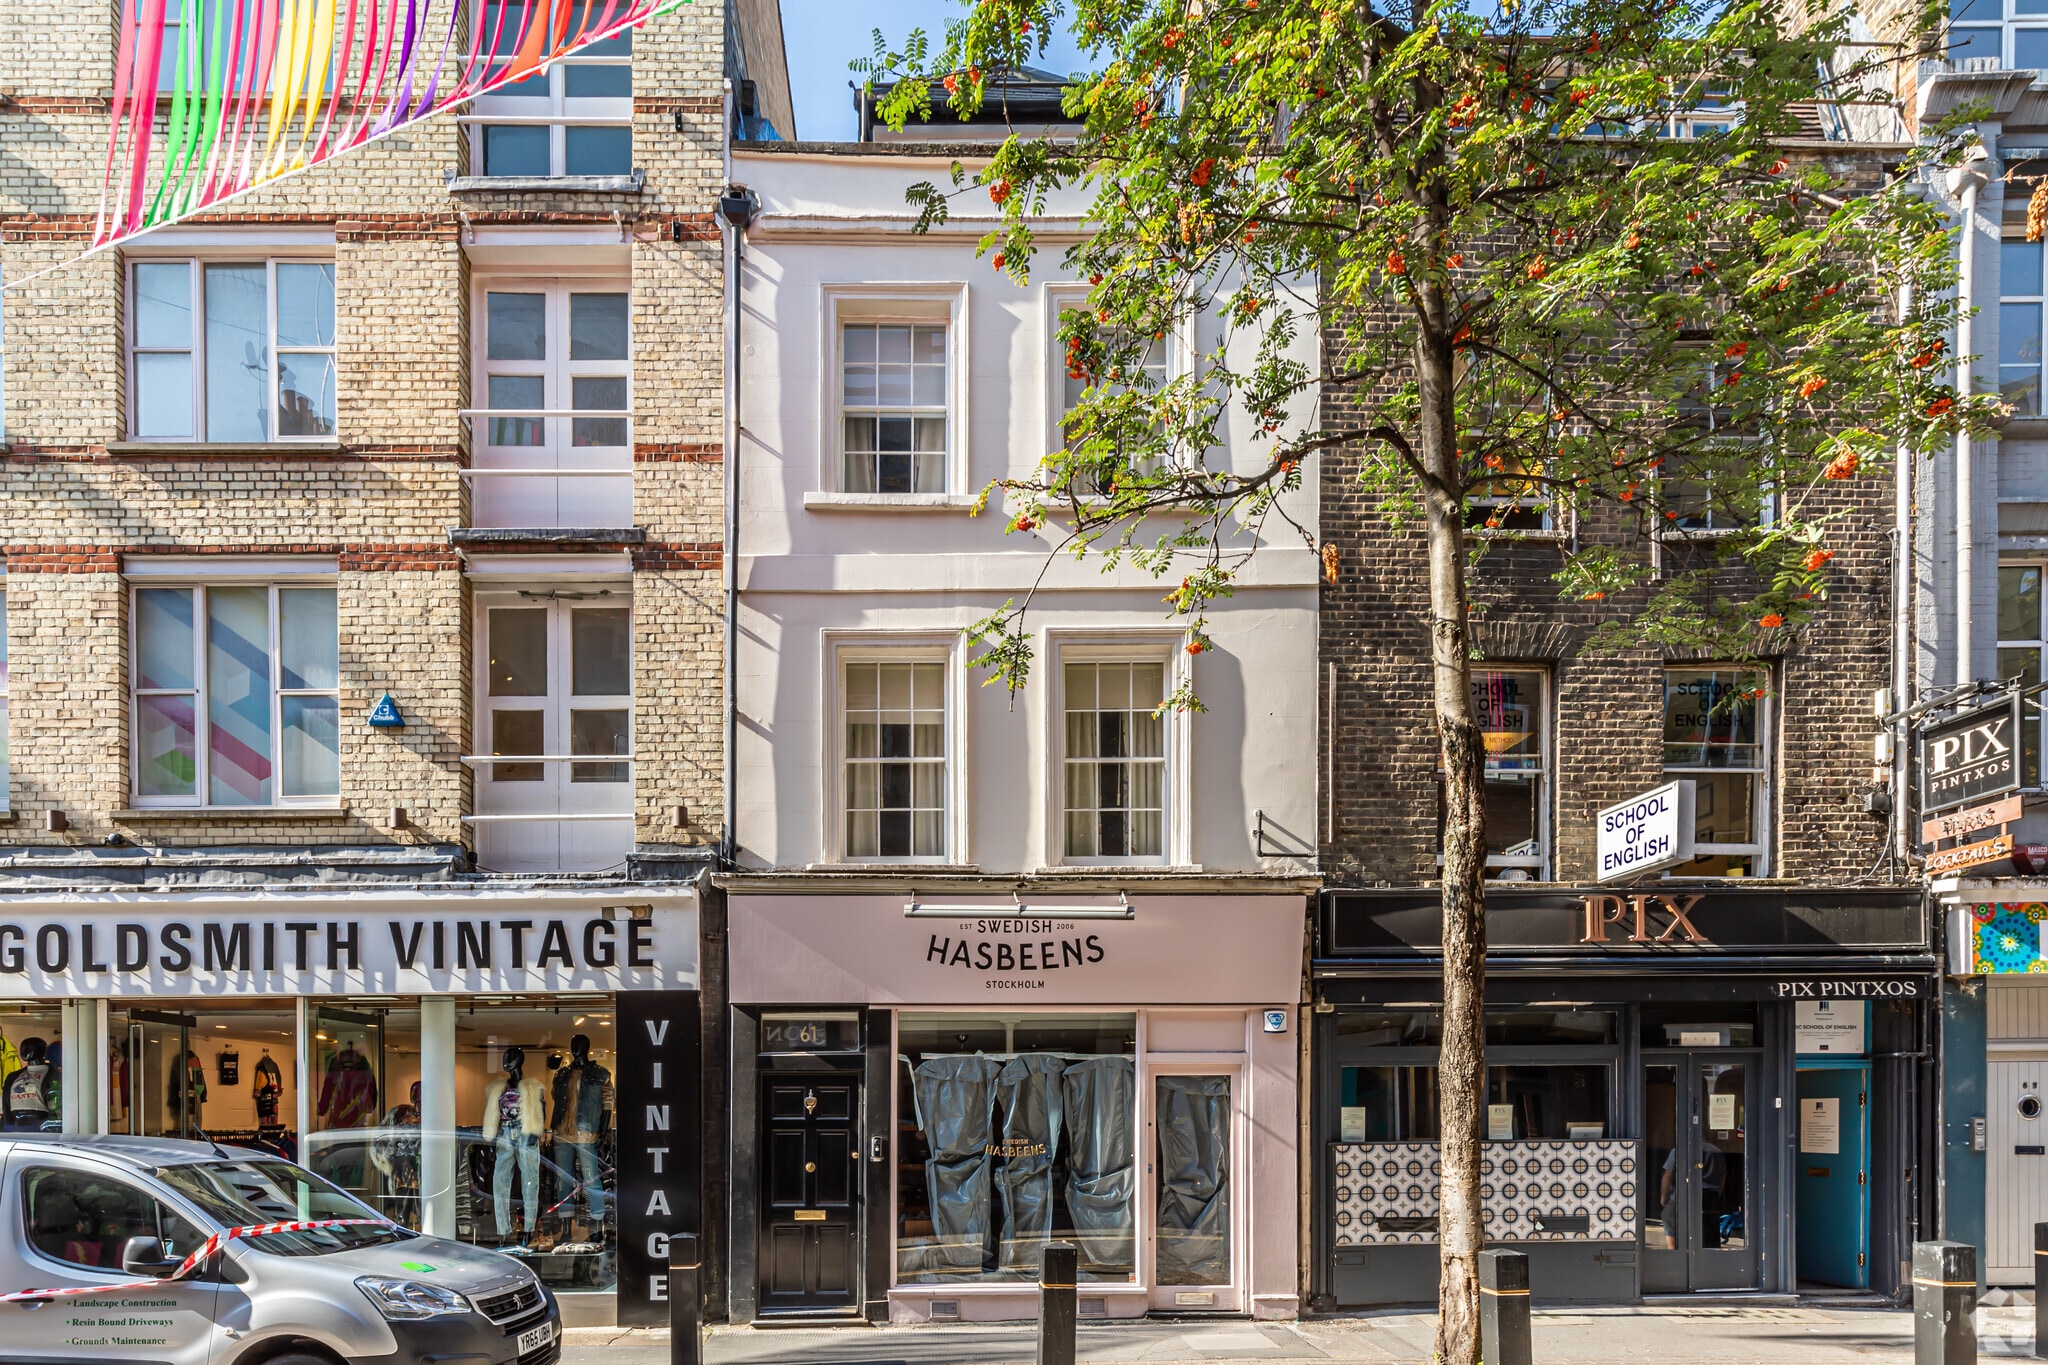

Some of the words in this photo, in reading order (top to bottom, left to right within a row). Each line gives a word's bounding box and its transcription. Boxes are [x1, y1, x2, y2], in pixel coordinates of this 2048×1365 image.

[1471, 682, 1523, 696] CHOOL
[1677, 682, 1736, 696] SCHOO
[1477, 714, 1523, 727] GLISH
[1675, 714, 1744, 727] ENGLISH
[1930, 717, 2010, 775] PIX
[1931, 759, 2010, 793] PINTXOS
[1606, 796, 1669, 833] SCHOOL
[1625, 823, 1646, 845] OF
[1604, 834, 1669, 871] ENGLISH
[1925, 842, 2007, 870] COCKTAILS
[977, 919, 1052, 934] SWEDISH
[1580, 894, 1709, 943] PIX
[0, 922, 359, 974] GOLDSMITH
[388, 918, 655, 970] VINTAGE
[926, 934, 1105, 971] HASBEENS
[985, 980, 1045, 989] STOCKHOLM
[1777, 982, 1816, 997] PIX
[1820, 981, 1918, 997] PINTXOS
[801, 1025, 817, 1043] 61
[985, 1143, 1047, 1157] HASBEENS
[645, 1020, 672, 1301] VINTAGE
[73, 1299, 120, 1308] Landscape
[121, 1298, 177, 1308] Construction
[72, 1317, 96, 1327] Resin
[98, 1317, 126, 1327] Bound
[128, 1317, 174, 1328] Driveways
[71, 1336, 109, 1346] Grounds
[111, 1336, 167, 1346] Maintenance
[521, 1332, 538, 1352] YR65
[538, 1324, 551, 1344] UBH
